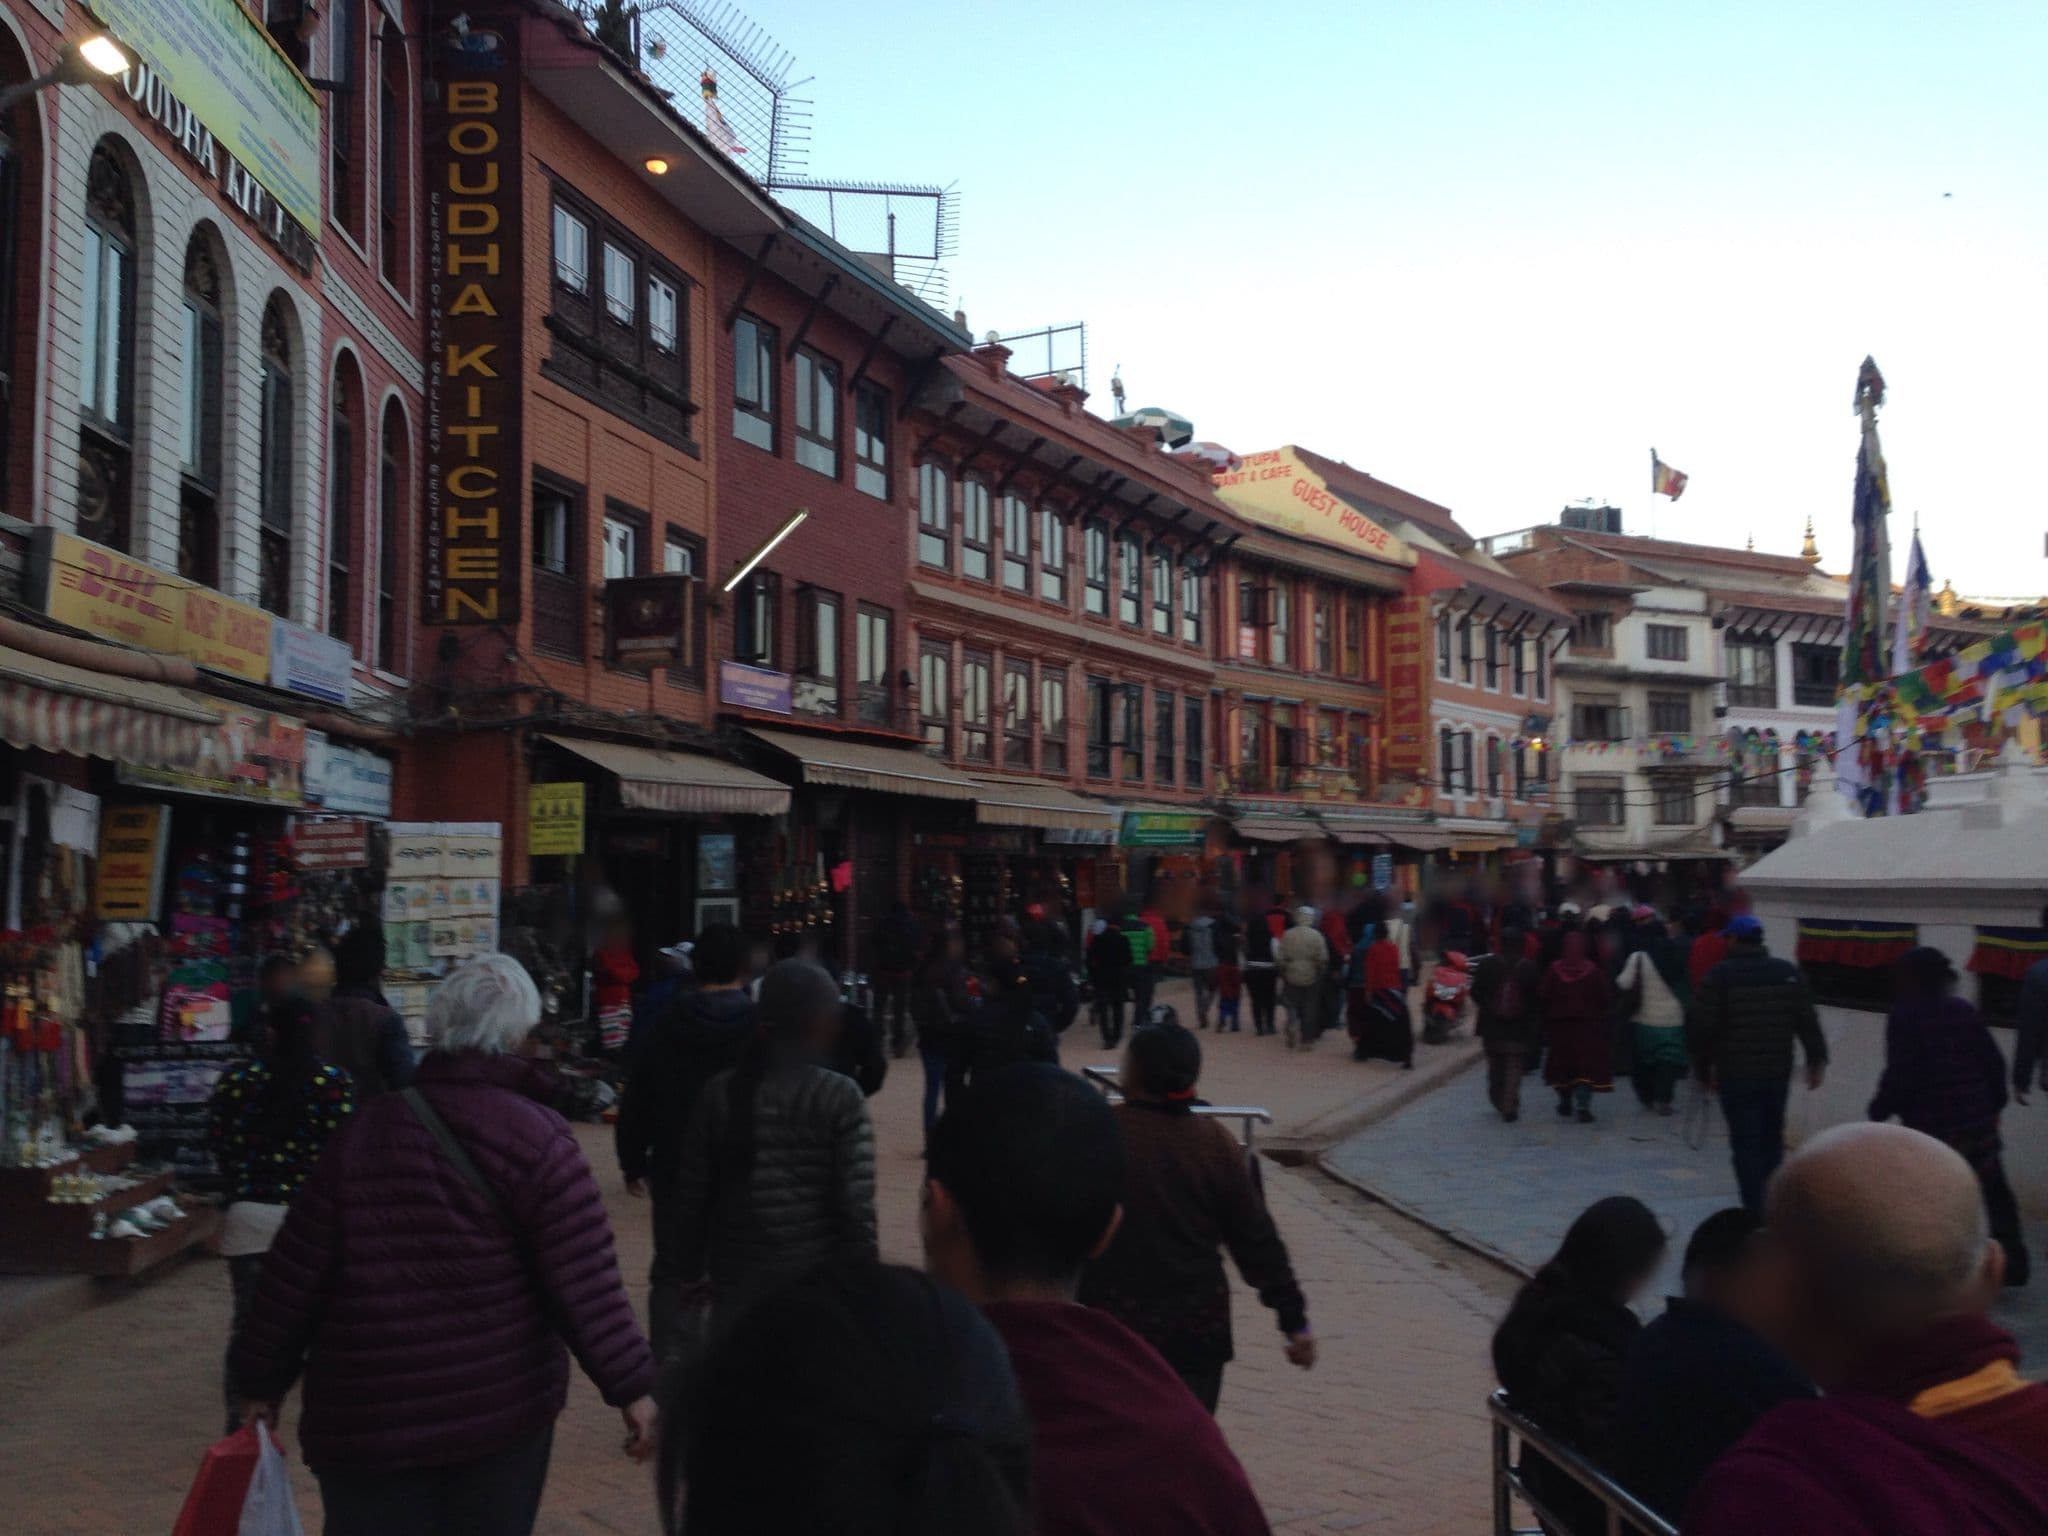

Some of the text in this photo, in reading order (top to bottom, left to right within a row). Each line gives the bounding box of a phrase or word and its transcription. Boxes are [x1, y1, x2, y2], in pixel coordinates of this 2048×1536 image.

[122, 63, 217, 180] OUDHA
[430, 192, 441, 274] ELEGANT
[430, 283, 441, 353] DINING
[446, 81, 499, 620] BOUDHA KITCHEN
[1242, 451, 1281, 468] TUPA
[1260, 464, 1292, 481] CAFE
[1292, 478, 1339, 518] GUEST
[1338, 507, 1390, 551] HOUSE
[80, 548, 163, 620] DHL
